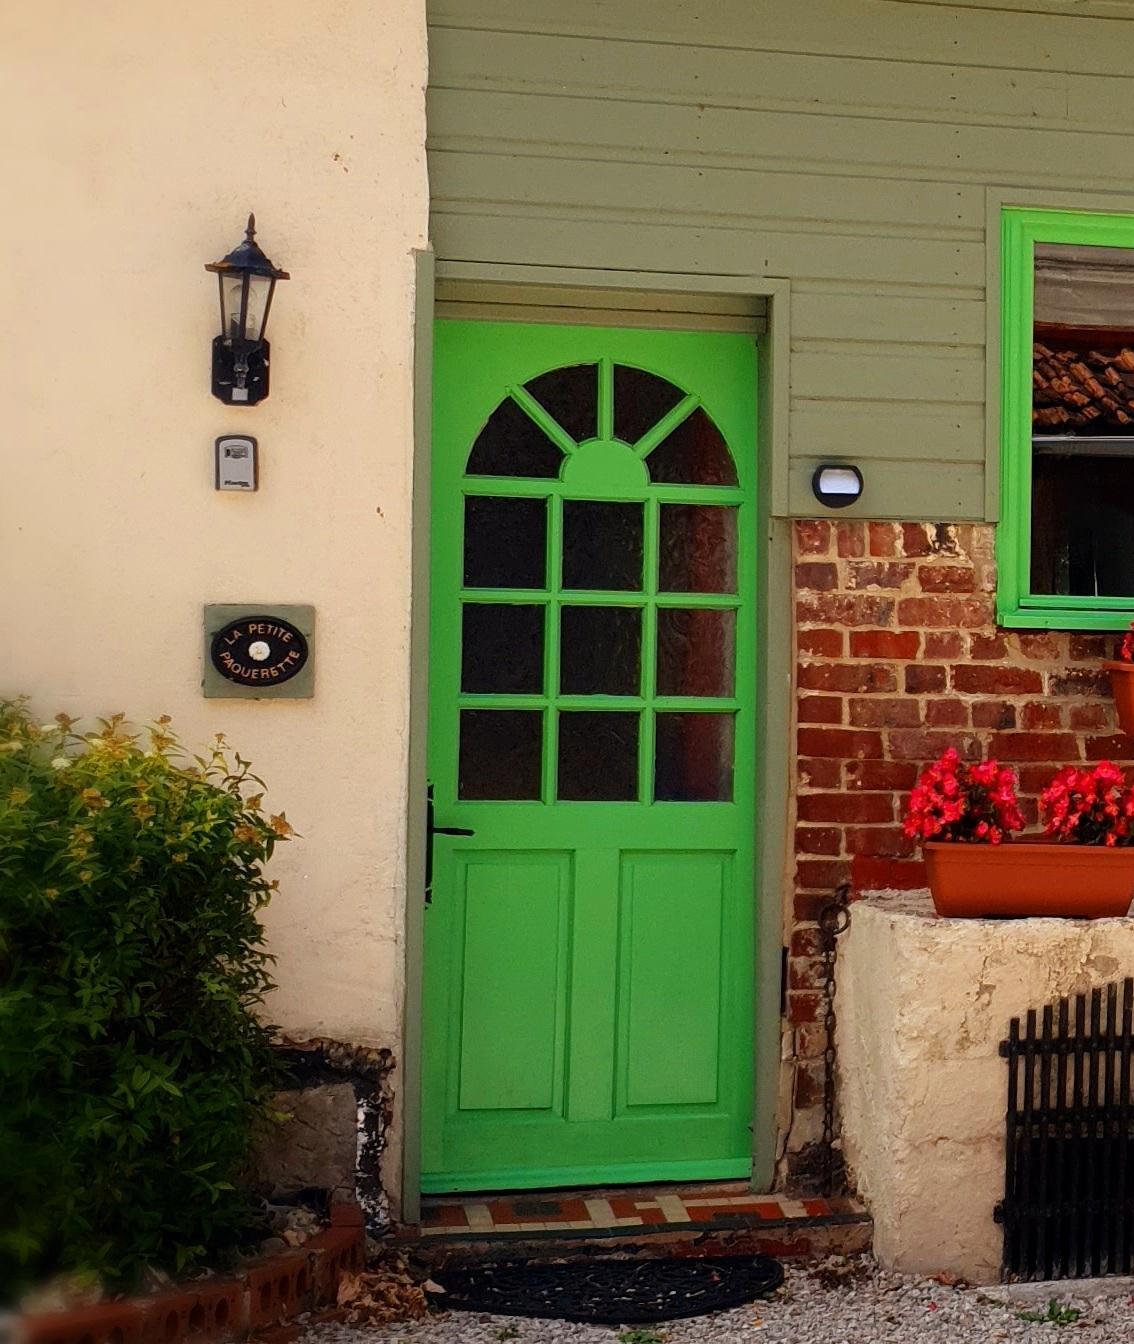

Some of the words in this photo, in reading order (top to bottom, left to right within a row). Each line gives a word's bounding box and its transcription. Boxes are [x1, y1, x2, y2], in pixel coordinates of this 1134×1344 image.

[224, 629, 242, 645] LA
[248, 623, 293, 643] PETITE
[219, 650, 300, 679] PAQUERETTE
